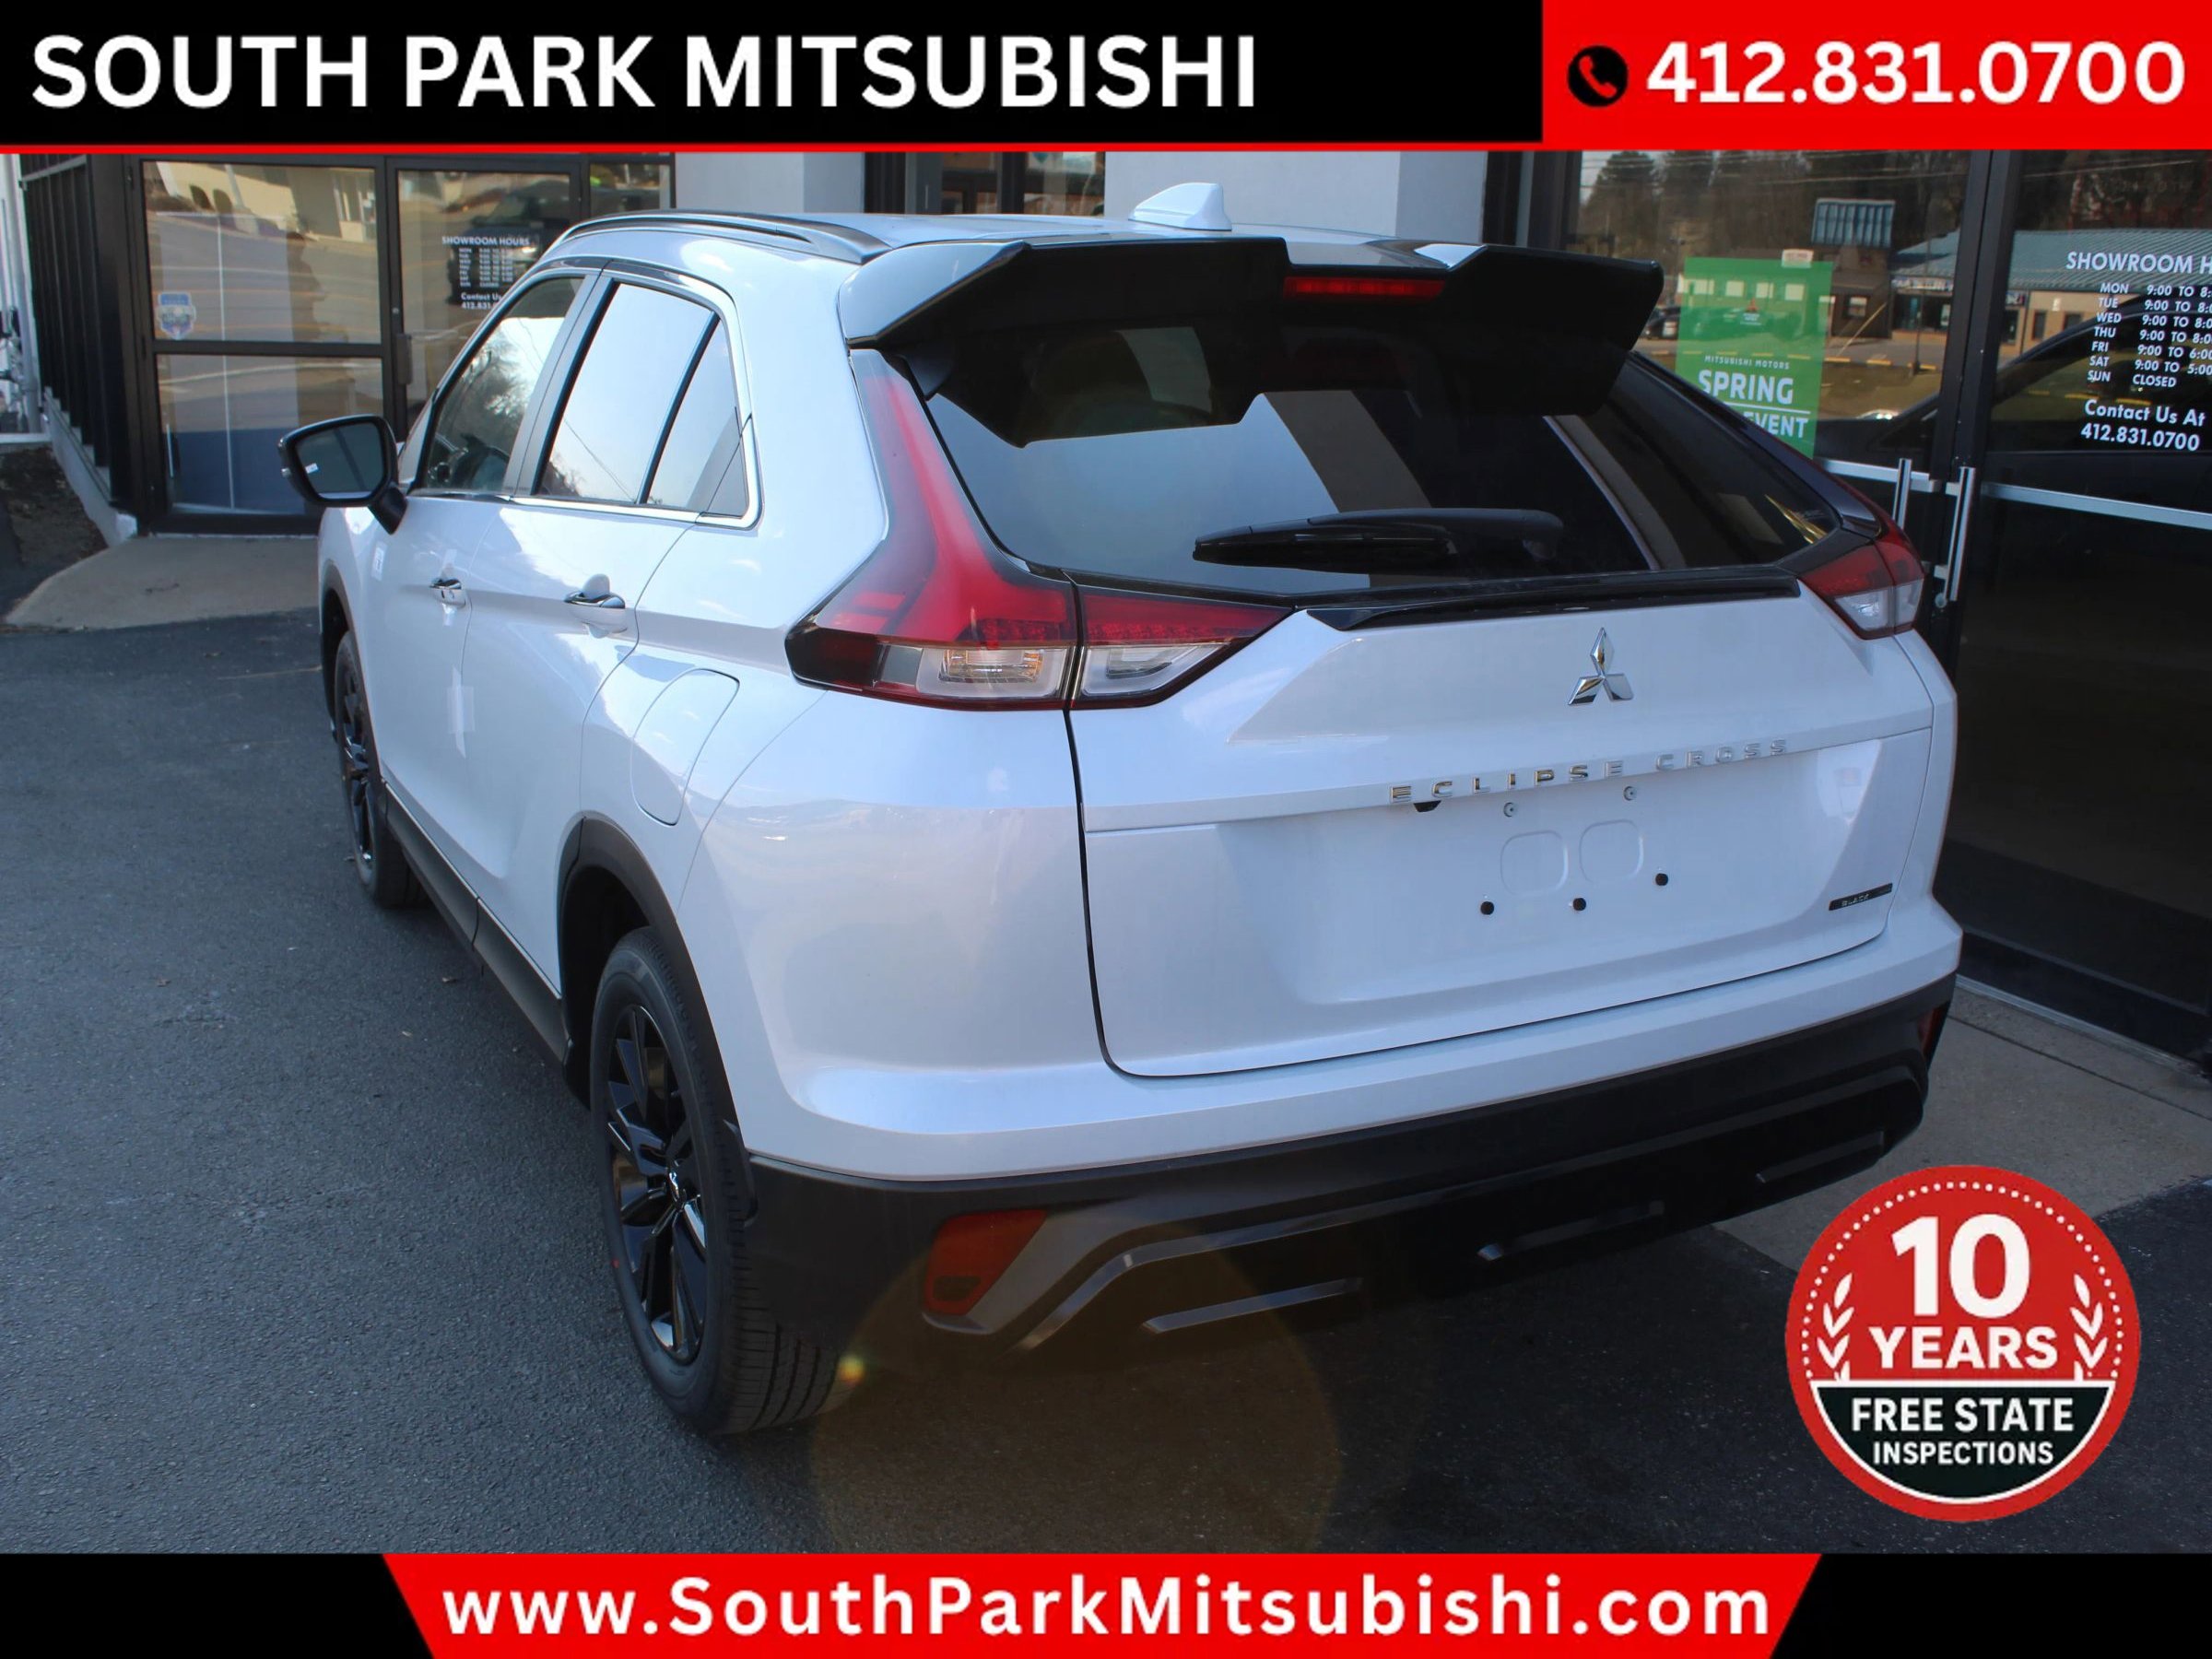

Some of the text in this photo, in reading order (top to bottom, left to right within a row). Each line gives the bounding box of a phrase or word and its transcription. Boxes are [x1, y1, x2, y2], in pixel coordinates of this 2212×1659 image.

[441, 236, 530, 246] SHOWROOM HOURS
[2065, 251, 2193, 274] SHOWROOM
[2100, 282, 2129, 294] MON
[2147, 285, 2171, 296] 9:00
[2179, 286, 2194, 297] TO
[2099, 297, 2119, 308] TUE
[2144, 300, 2169, 311] 9:00
[2175, 300, 2191, 312] TO
[2096, 312, 2122, 324] WED
[2142, 315, 2167, 326] 9:00
[2173, 316, 2189, 327] TO
[2094, 326, 2116, 337] THU
[2139, 330, 2165, 341] 9:00
[2171, 331, 2187, 342] TO
[2091, 341, 2109, 352] FRI
[2137, 345, 2162, 356] 9:00
[2169, 346, 2183, 358] TO
[1704, 355, 1790, 370] MITSUBISHI MOTORS
[2089, 356, 2110, 367] SAT
[2135, 359, 2159, 371] 9:00
[2164, 361, 2180, 372] TO
[1699, 369, 1794, 405] SPRING
[2087, 371, 2177, 387] SUN CLOSED
[2085, 399, 2206, 427] Contact Us At
[2081, 423, 2200, 452] 412.831.0700
[1391, 739, 1787, 805] ECLIPSE CROSS
